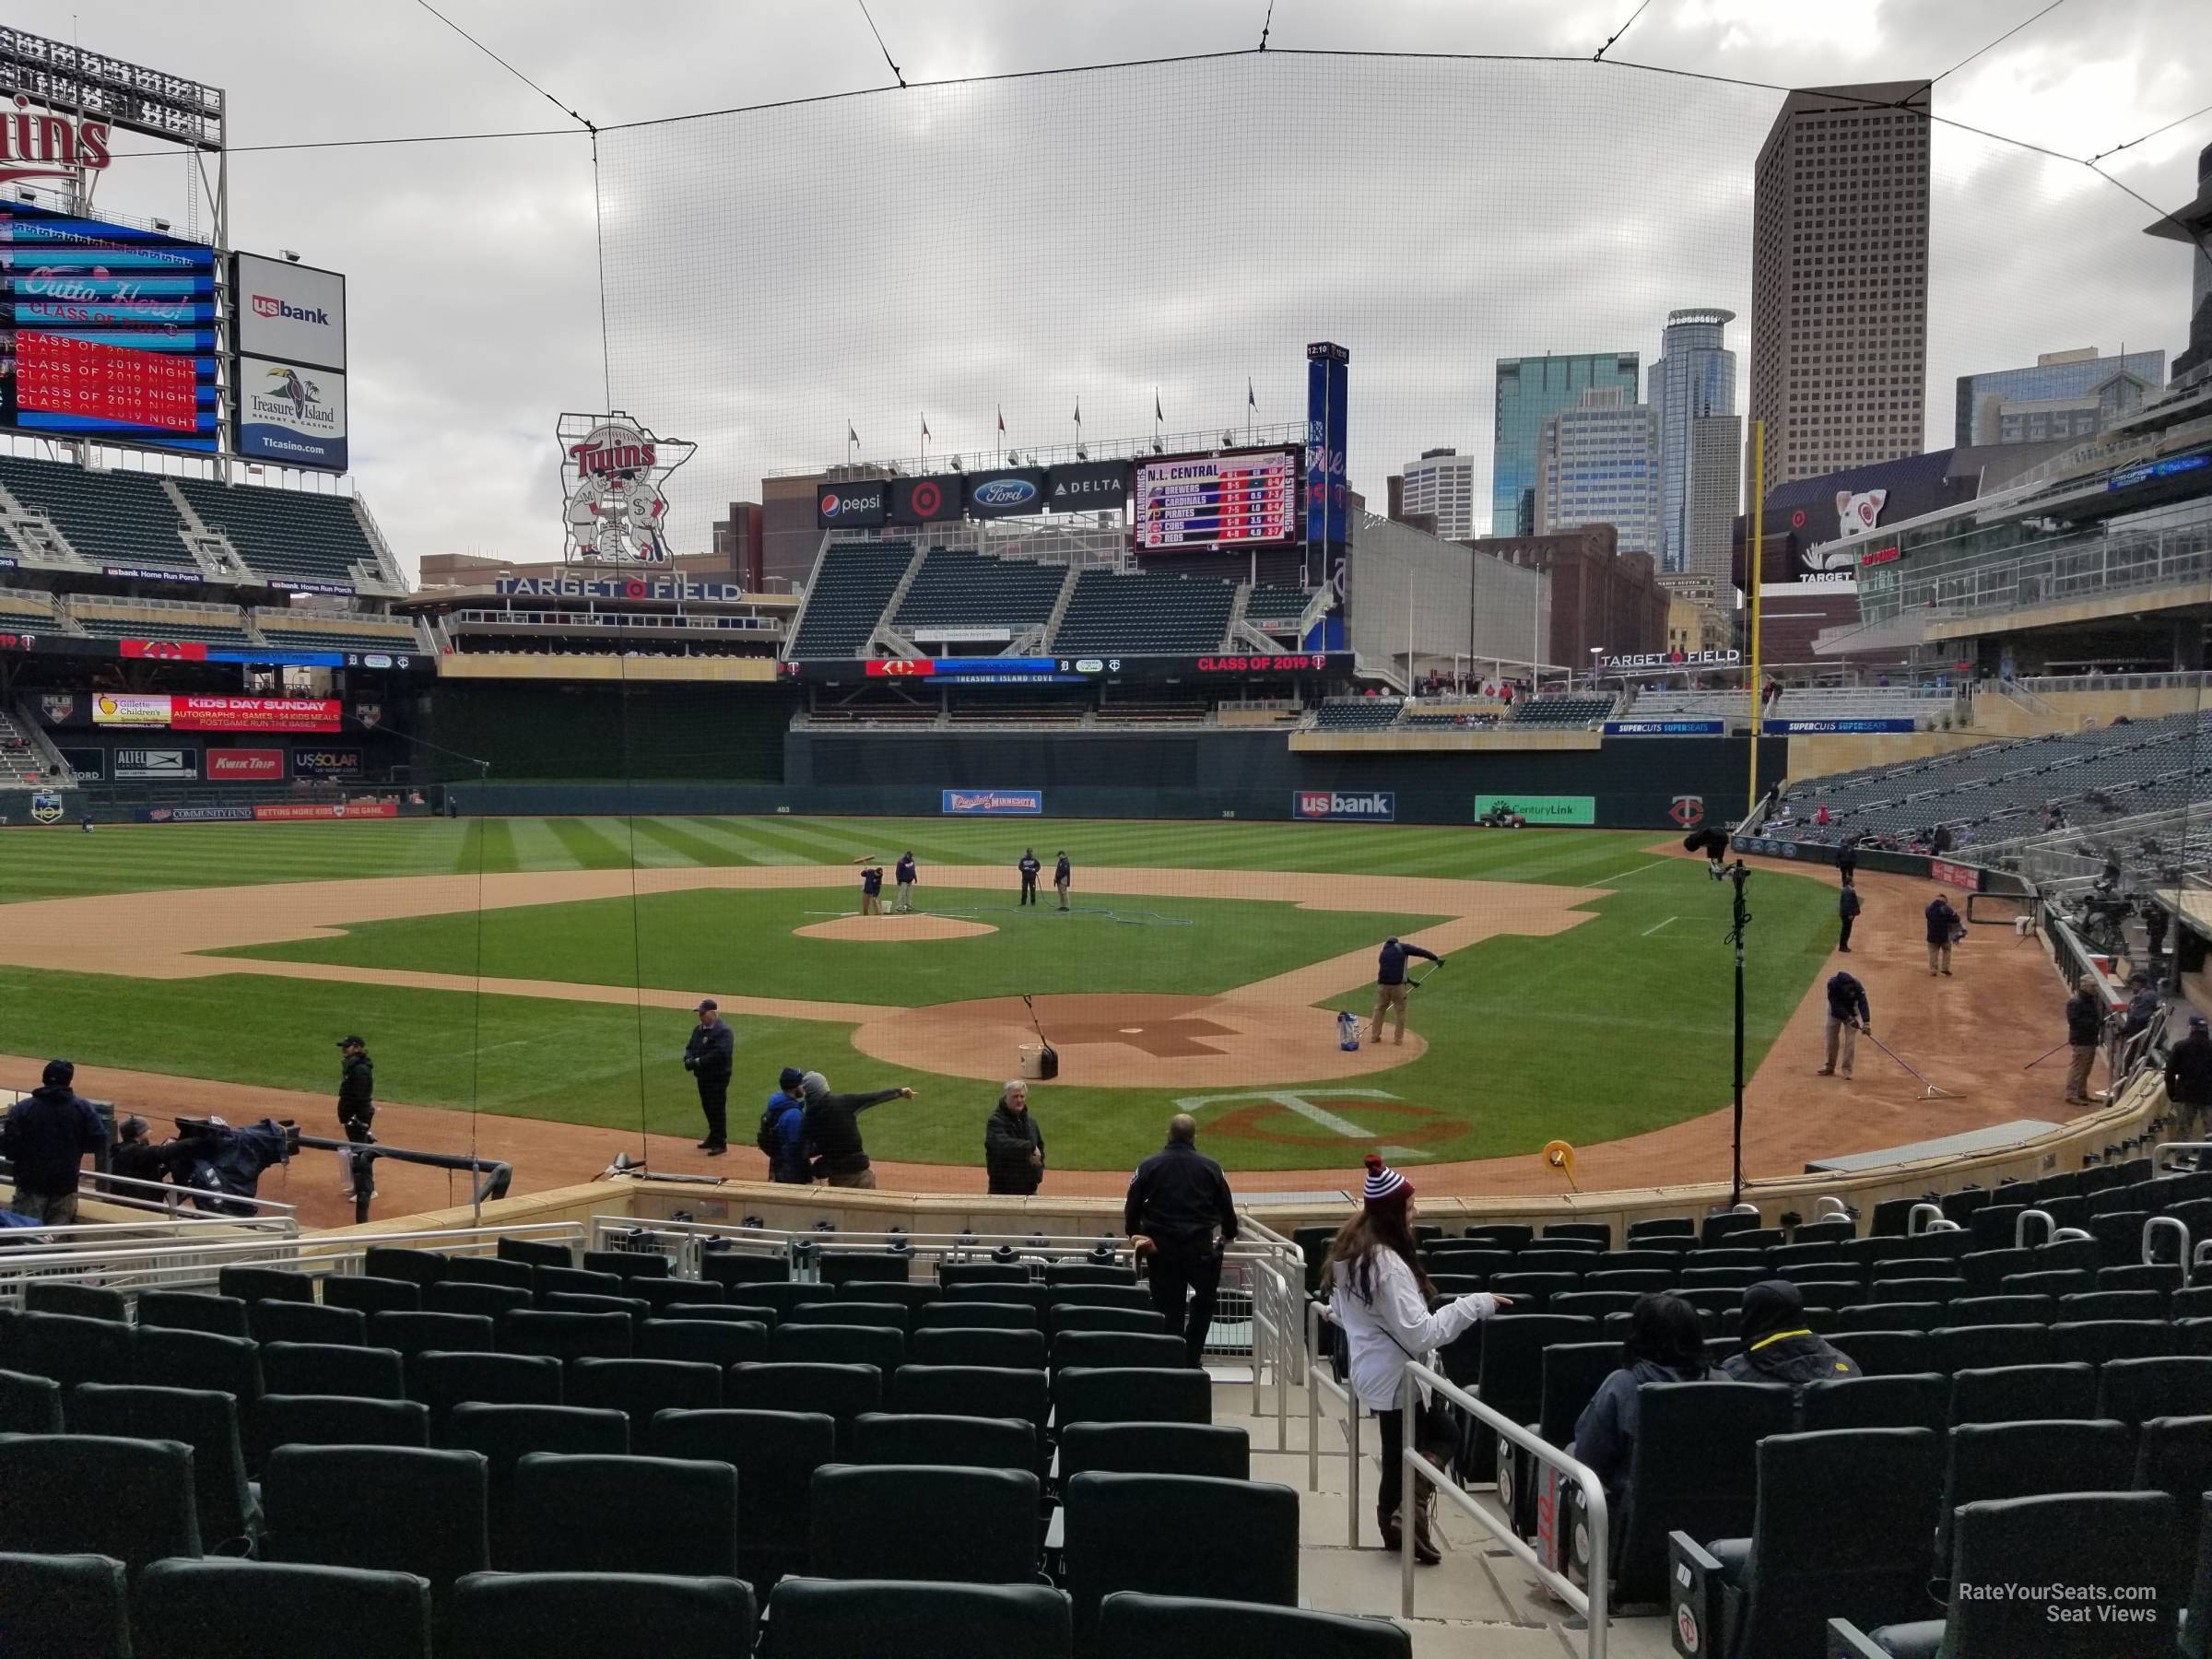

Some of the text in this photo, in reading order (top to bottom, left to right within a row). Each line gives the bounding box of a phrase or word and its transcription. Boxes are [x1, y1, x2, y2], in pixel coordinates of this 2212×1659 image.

[29, 301, 88, 323] CLASS
[93, 312, 115, 325] OF
[16, 330, 70, 347] CLASS
[79, 342, 100, 352] OF
[1308, 345, 1327, 355] 12:10
[17, 359, 71, 373] CLASS
[79, 366, 100, 377] OF
[107, 371, 141, 382] 2019
[149, 365, 195, 380] NIGHT
[80, 391, 100, 402] OF
[108, 395, 142, 406] 2019
[149, 390, 196, 404] NIGHT
[17, 394, 71, 409] CLASS
[150, 414, 196, 428] NIGHT
[251, 394, 334, 423] Treasure Island
[252, 413, 287, 423] RESORT
[300, 421, 334, 430] CASINO
[570, 440, 656, 478] Twins
[1147, 465, 1218, 481] N.L. CENTRAL
[986, 484, 1023, 502] Ford
[1071, 479, 1121, 493] DELTA
[1164, 485, 1200, 495] BREWERS
[1136, 468, 1146, 522] STANDINGS
[1164, 496, 1206, 507] CARDINALS
[1268, 490, 1279, 499] 7-3
[842, 494, 879, 513] pepsi
[1285, 477, 1294, 532] STANDINGS
[1164, 509, 1194, 519] PIRATES
[1164, 521, 1185, 531] CUBS
[1250, 516, 1262, 524] 3.5
[1164, 533, 1183, 543] REDS
[1267, 527, 1279, 535] 3-7
[140, 571, 162, 579] Home
[163, 572, 178, 581] Run
[179, 573, 200, 582] Porch
[1799, 572, 1853, 582] TARGET
[498, 577, 742, 601] TARGET FIELD
[1198, 656, 1309, 671] CLASS OF 2019
[1600, 649, 1740, 667] TARGET FIELD
[120, 700, 150, 708] Gillette
[188, 698, 326, 711] KIDS DAY SUNDAY
[120, 708, 161, 716] Children's
[1618, 724, 1709, 733] SUPERCUTS SUPERSEATS
[1789, 722, 1888, 731] SUPERCUTS SUPERSEATS
[991, 797, 1037, 808] MINNESOTA
[172, 808, 229, 818] COMMUNITY
[229, 808, 252, 818] FUND
[257, 806, 289, 817] GETTING
[291, 806, 313, 816] MORE
[314, 806, 333, 815] KIDS
[346, 806, 359, 815] THE
[1512, 805, 1573, 817] CenturyLink
